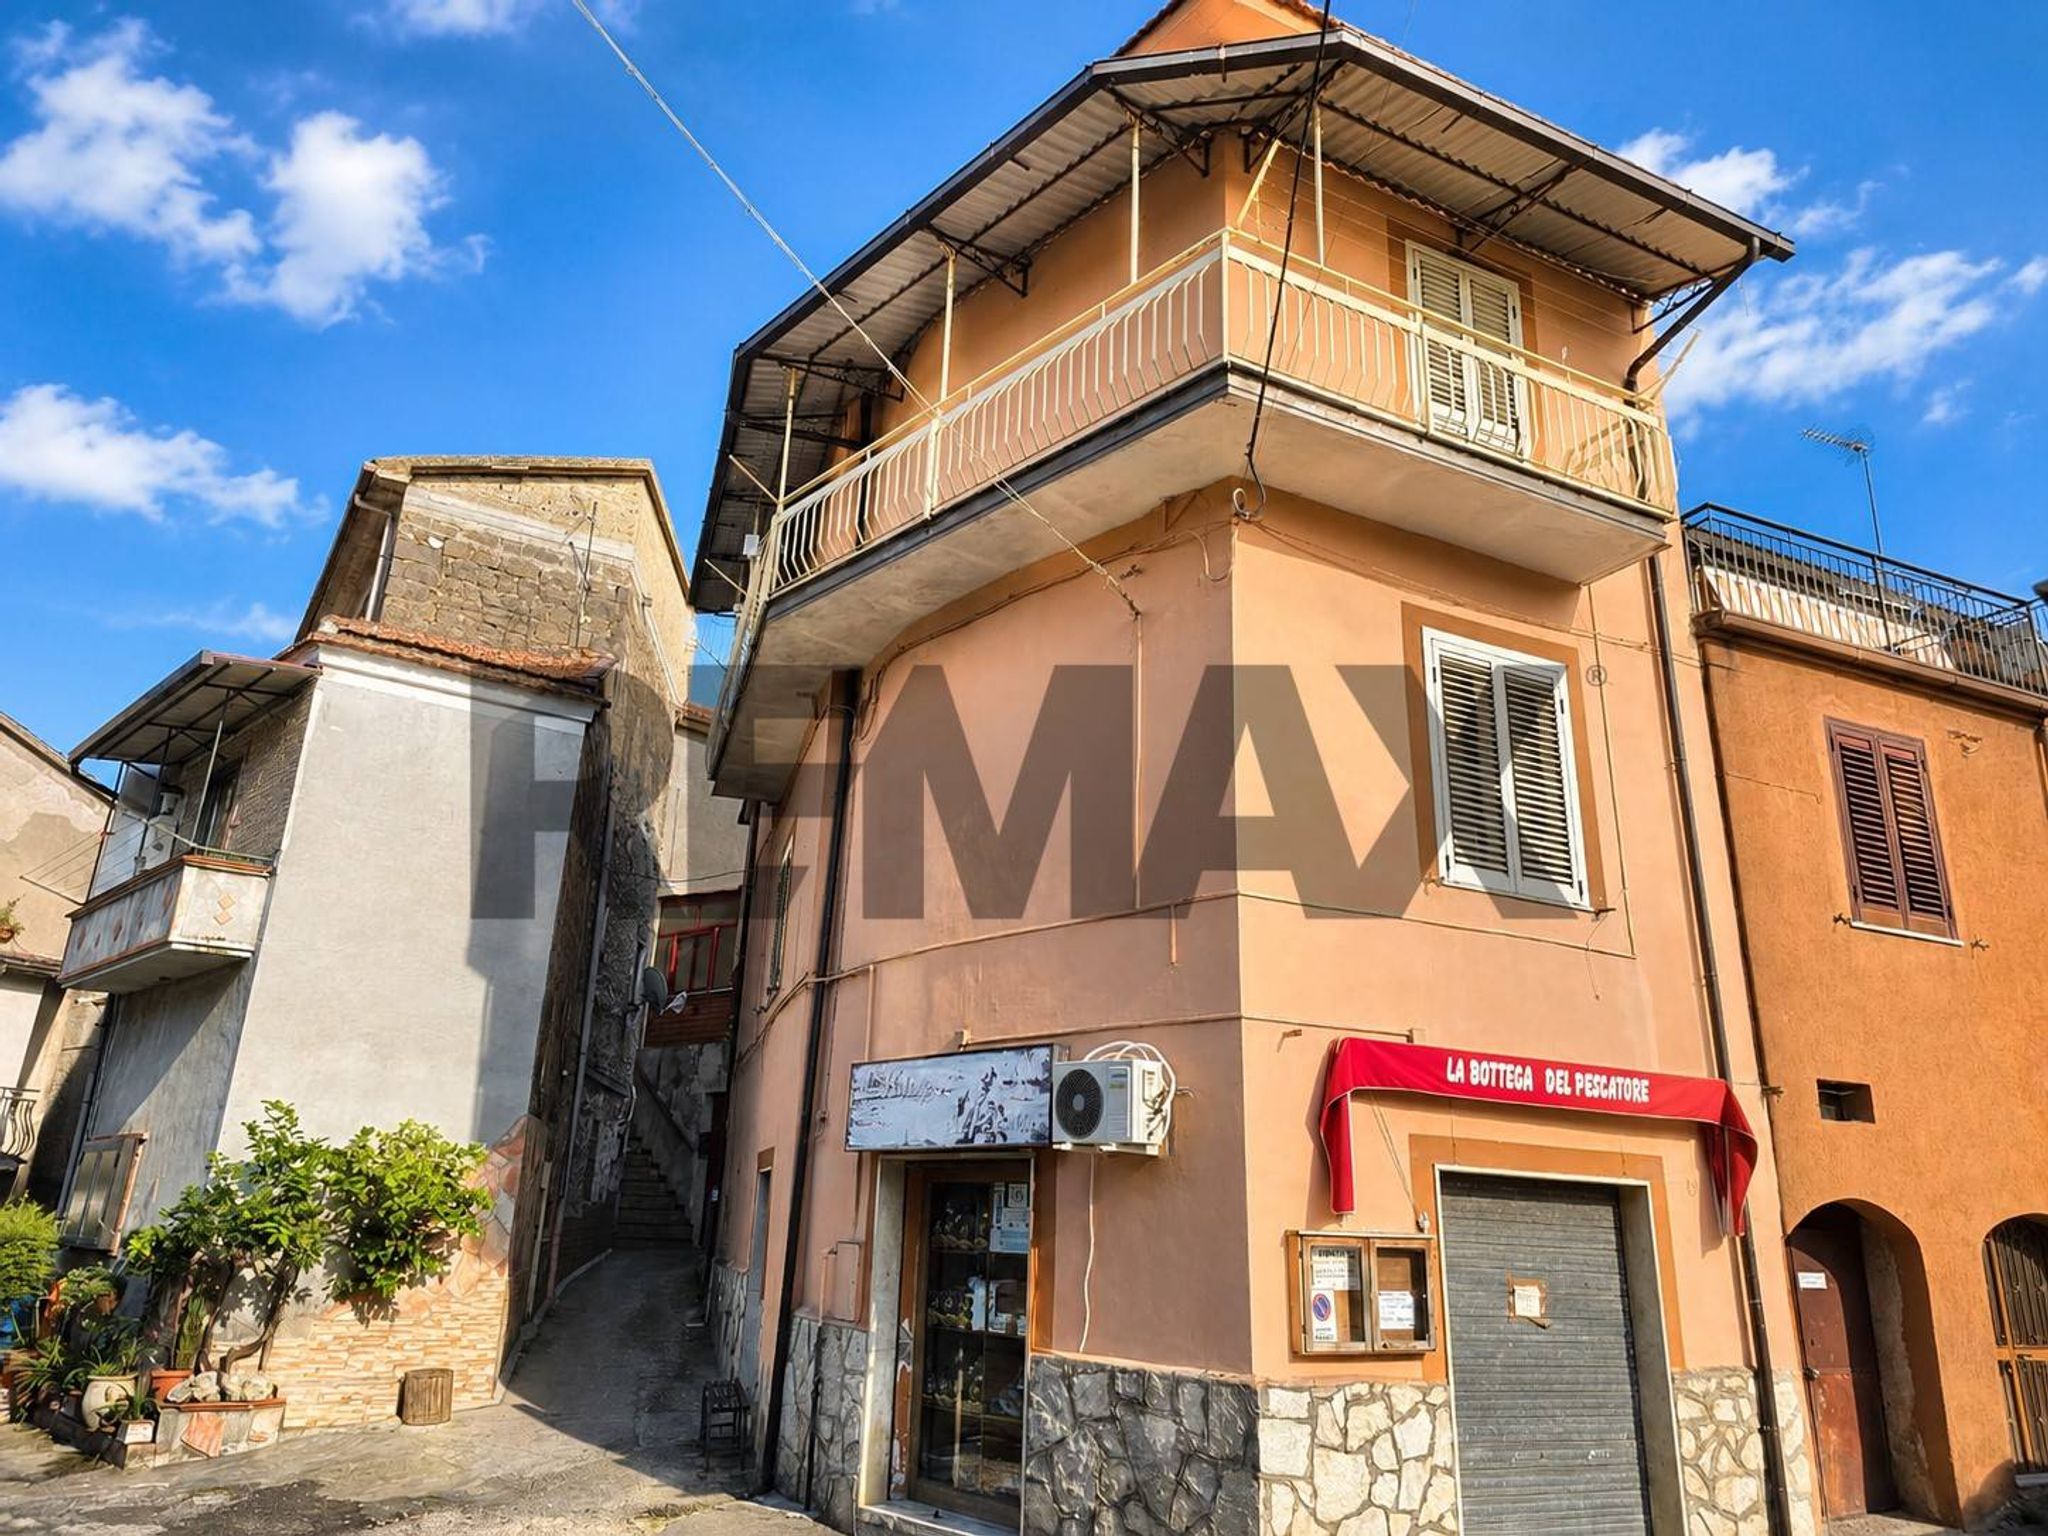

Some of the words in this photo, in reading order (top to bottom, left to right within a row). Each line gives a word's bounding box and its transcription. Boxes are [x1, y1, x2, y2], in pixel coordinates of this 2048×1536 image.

[1446, 1056, 1465, 1084] LA
[1470, 1059, 1534, 1092] BOTTEGA
[1545, 1068, 1572, 1096] DEL
[1575, 1072, 1650, 1103] PESCATORE
